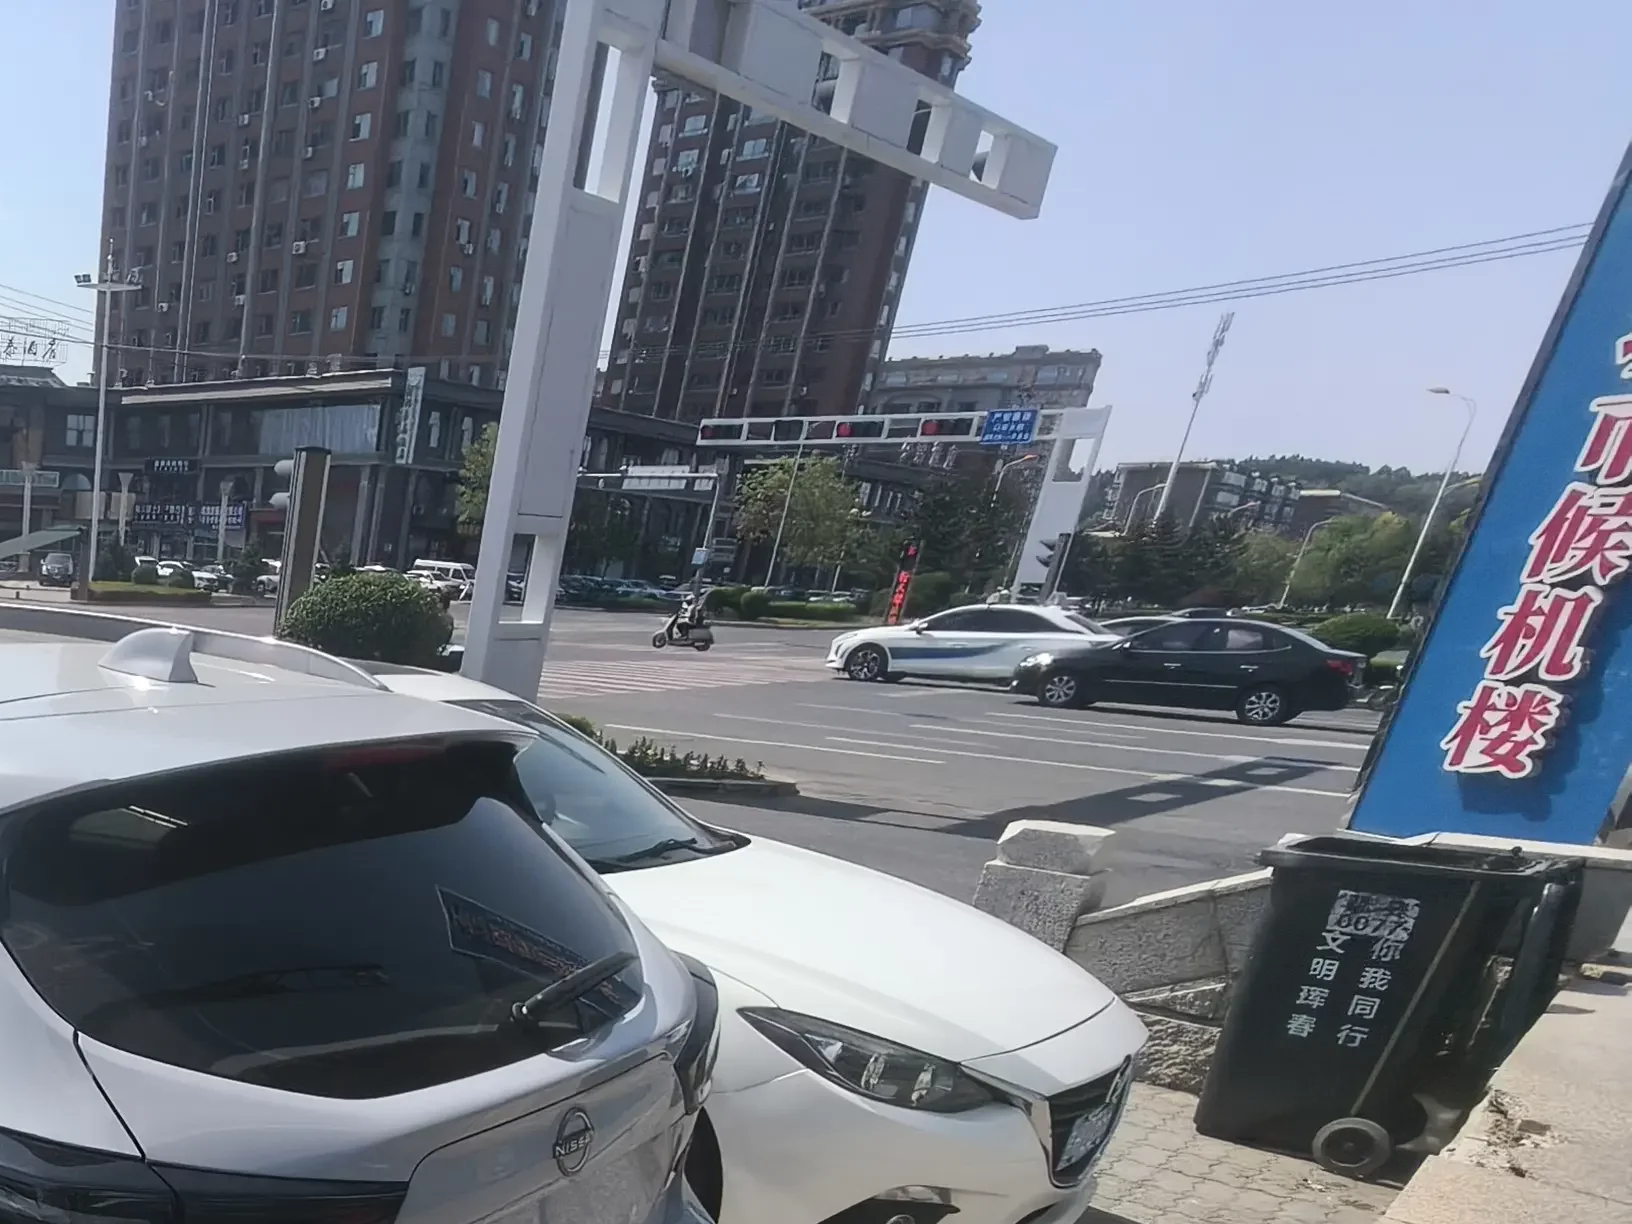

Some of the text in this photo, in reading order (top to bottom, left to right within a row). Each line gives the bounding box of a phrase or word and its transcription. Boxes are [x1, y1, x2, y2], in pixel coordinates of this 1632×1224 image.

[1286, 931, 1351, 1038] 文明珲春
[1337, 936, 1405, 1047] 你我同行
